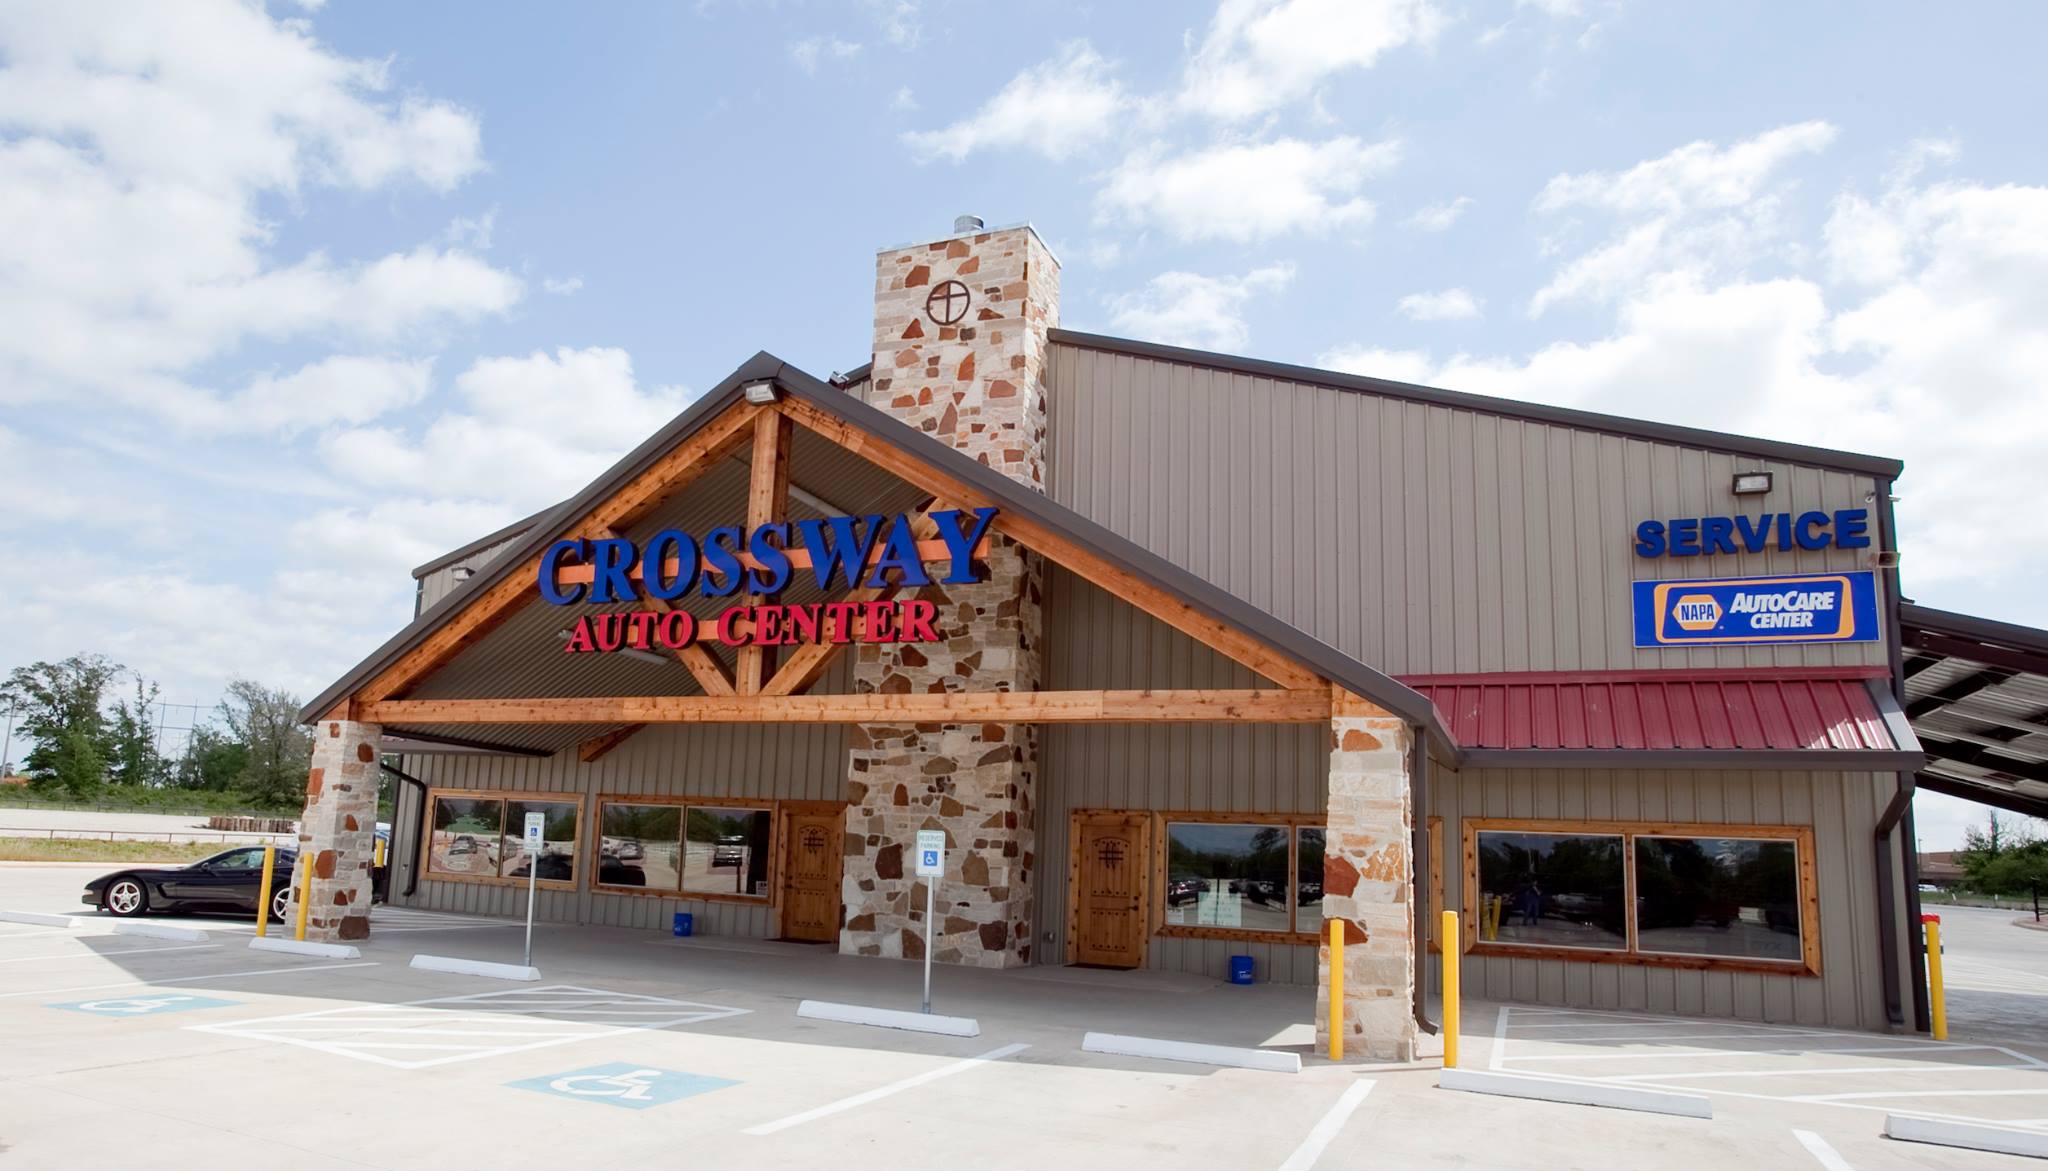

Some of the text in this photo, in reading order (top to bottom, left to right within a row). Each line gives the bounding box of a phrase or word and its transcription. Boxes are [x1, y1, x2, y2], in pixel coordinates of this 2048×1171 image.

[538, 507, 999, 606] CROSSWAY
[1635, 508, 1871, 558] SERVICE
[566, 600, 944, 653] AUTO CENTER
[1681, 603, 1715, 621] NAPA
[1750, 612, 1813, 629] CENTER
